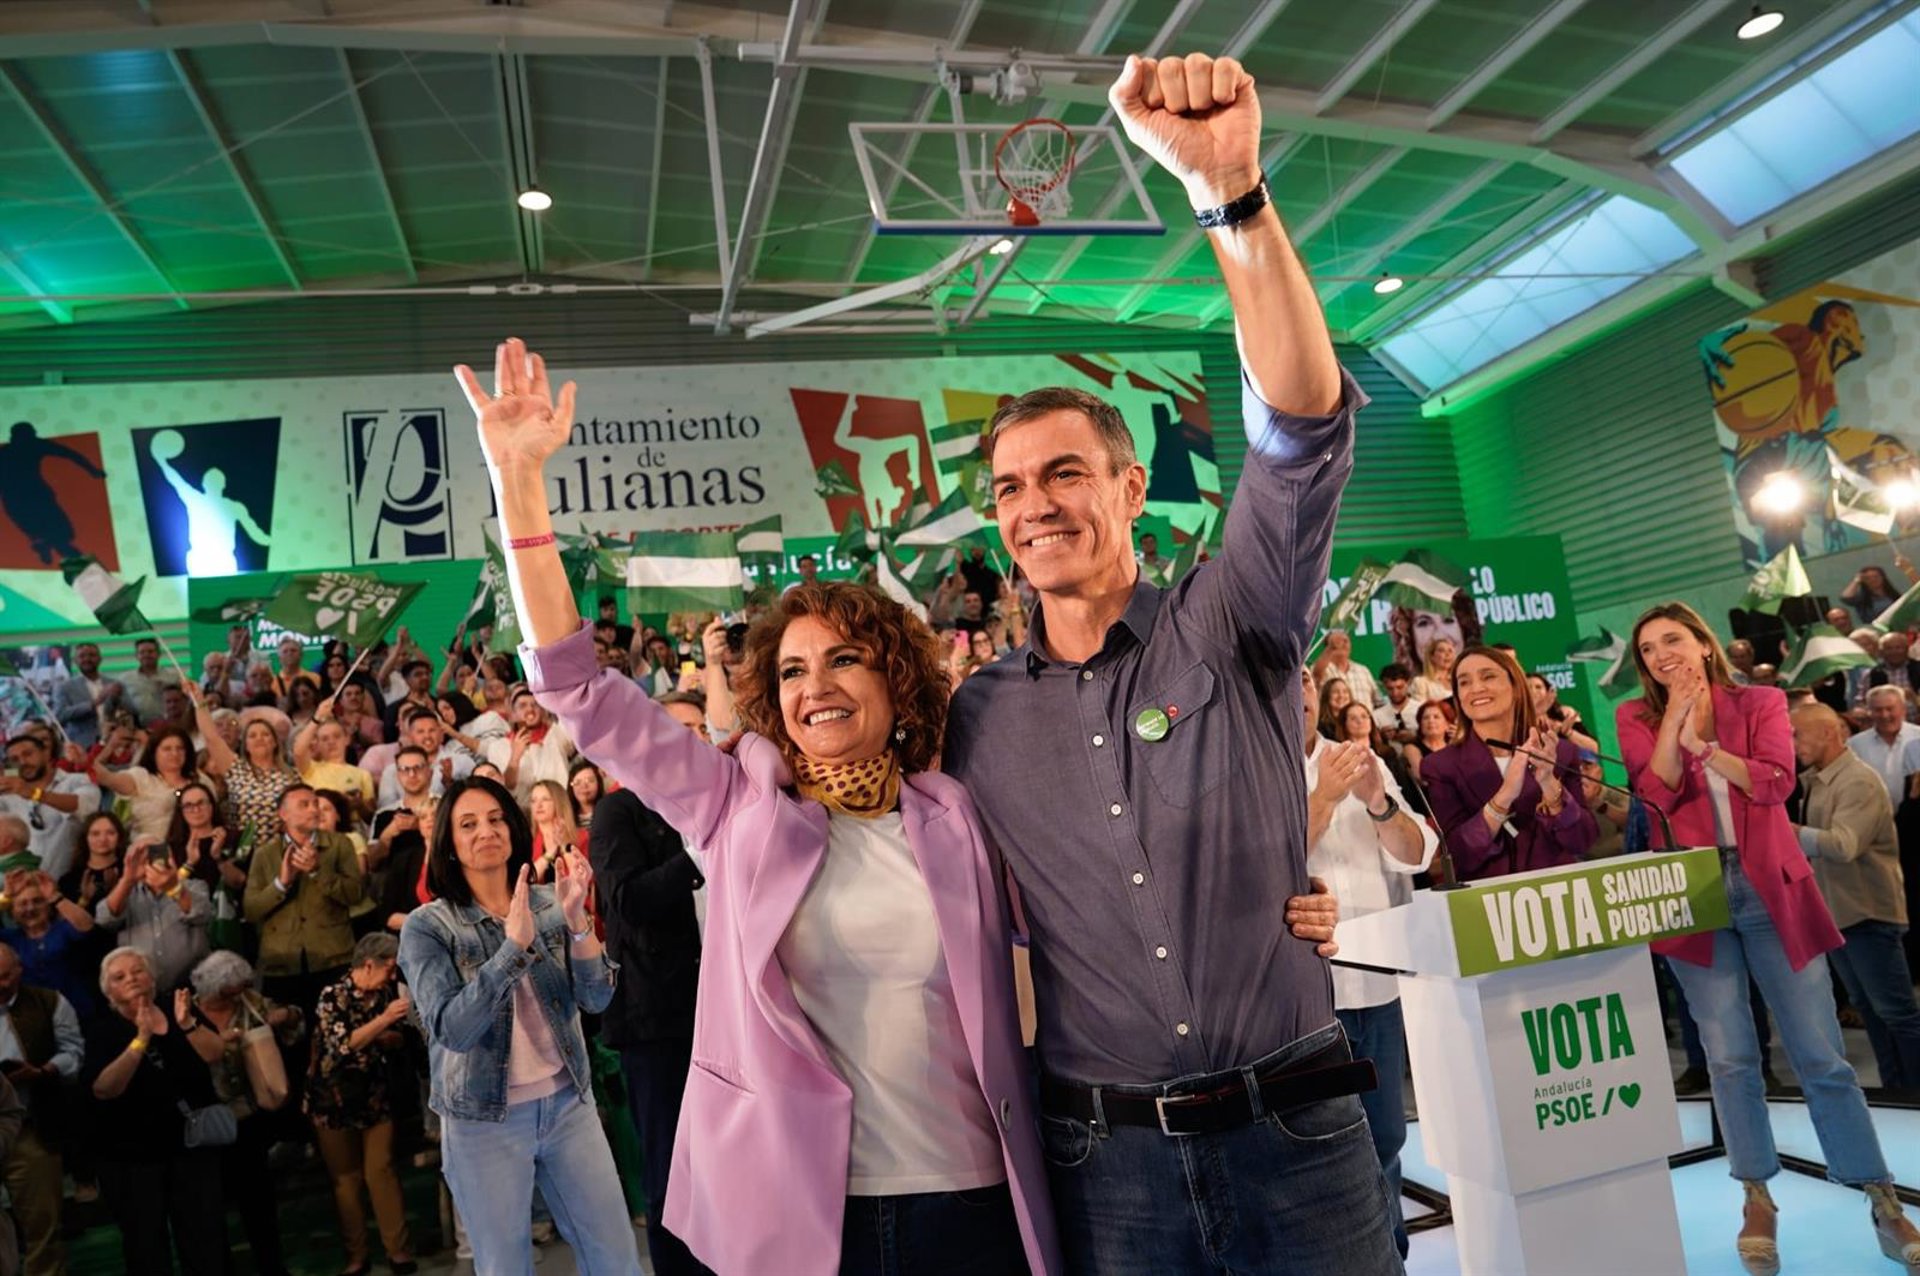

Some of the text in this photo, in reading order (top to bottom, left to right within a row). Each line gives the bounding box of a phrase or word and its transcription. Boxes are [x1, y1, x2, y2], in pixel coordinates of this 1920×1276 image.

[637, 446, 666, 467] de
[1475, 591, 1556, 625] PÚBLICO
[1546, 671, 1576, 689] SOE
[1602, 862, 1687, 905] SANIDAD
[1482, 877, 1604, 962] VOTA
[1607, 896, 1695, 941] PÚBLICA
[1521, 993, 1635, 1076] VOTA
[1534, 1077, 1592, 1099] Andalucía
[1535, 1093, 1596, 1130] PSOE
